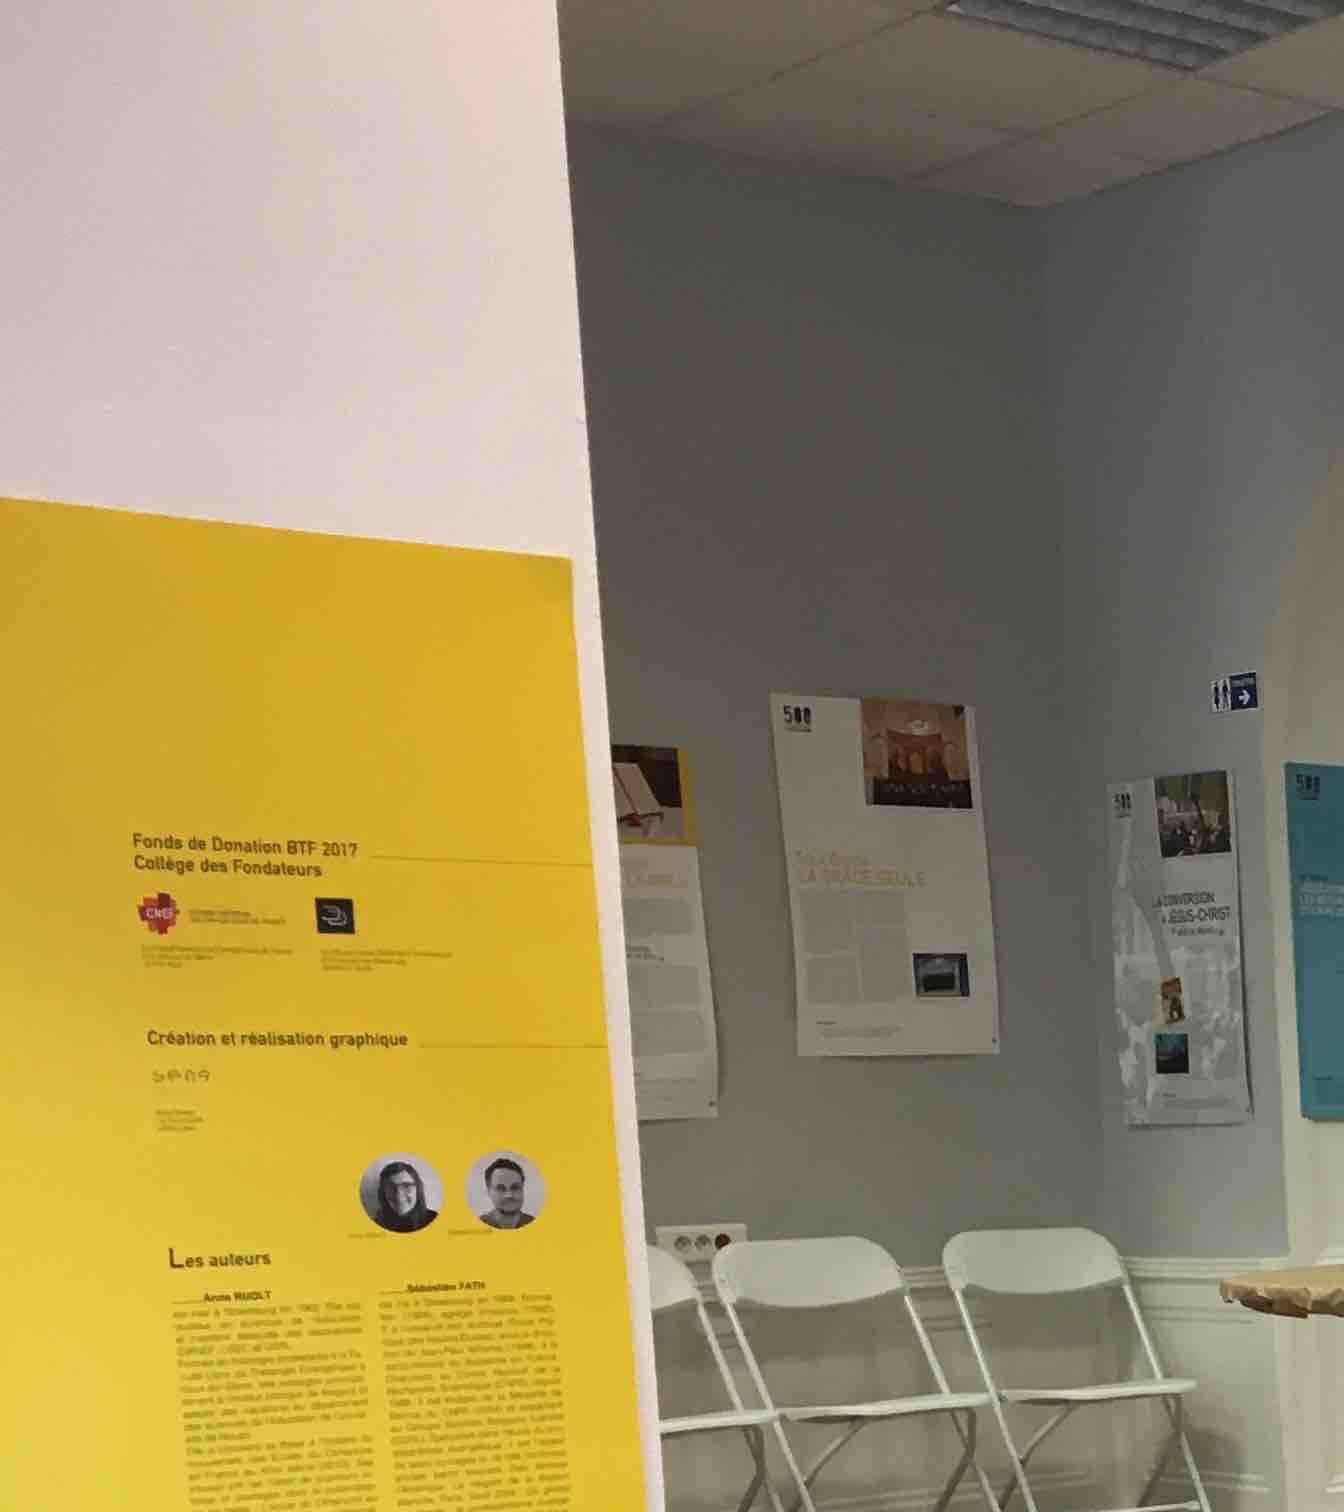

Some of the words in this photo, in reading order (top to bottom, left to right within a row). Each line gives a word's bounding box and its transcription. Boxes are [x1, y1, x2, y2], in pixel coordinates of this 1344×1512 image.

[132, 832, 183, 850] Fonds
[187, 835, 207, 851] de
[211, 836, 282, 854] Donation
[286, 839, 316, 857] BTF
[322, 841, 358, 857] 2017
[134, 854, 194, 875] Collège
[200, 858, 228, 873] des
[232, 859, 322, 877] Fondateurs
[147, 1029, 215, 1046] Création
[221, 1031, 236, 1046] et
[240, 1031, 325, 1047] réalisation
[329, 1032, 409, 1050] graphique
[169, 1248, 204, 1268] Les
[208, 1252, 272, 1268] auteurs
